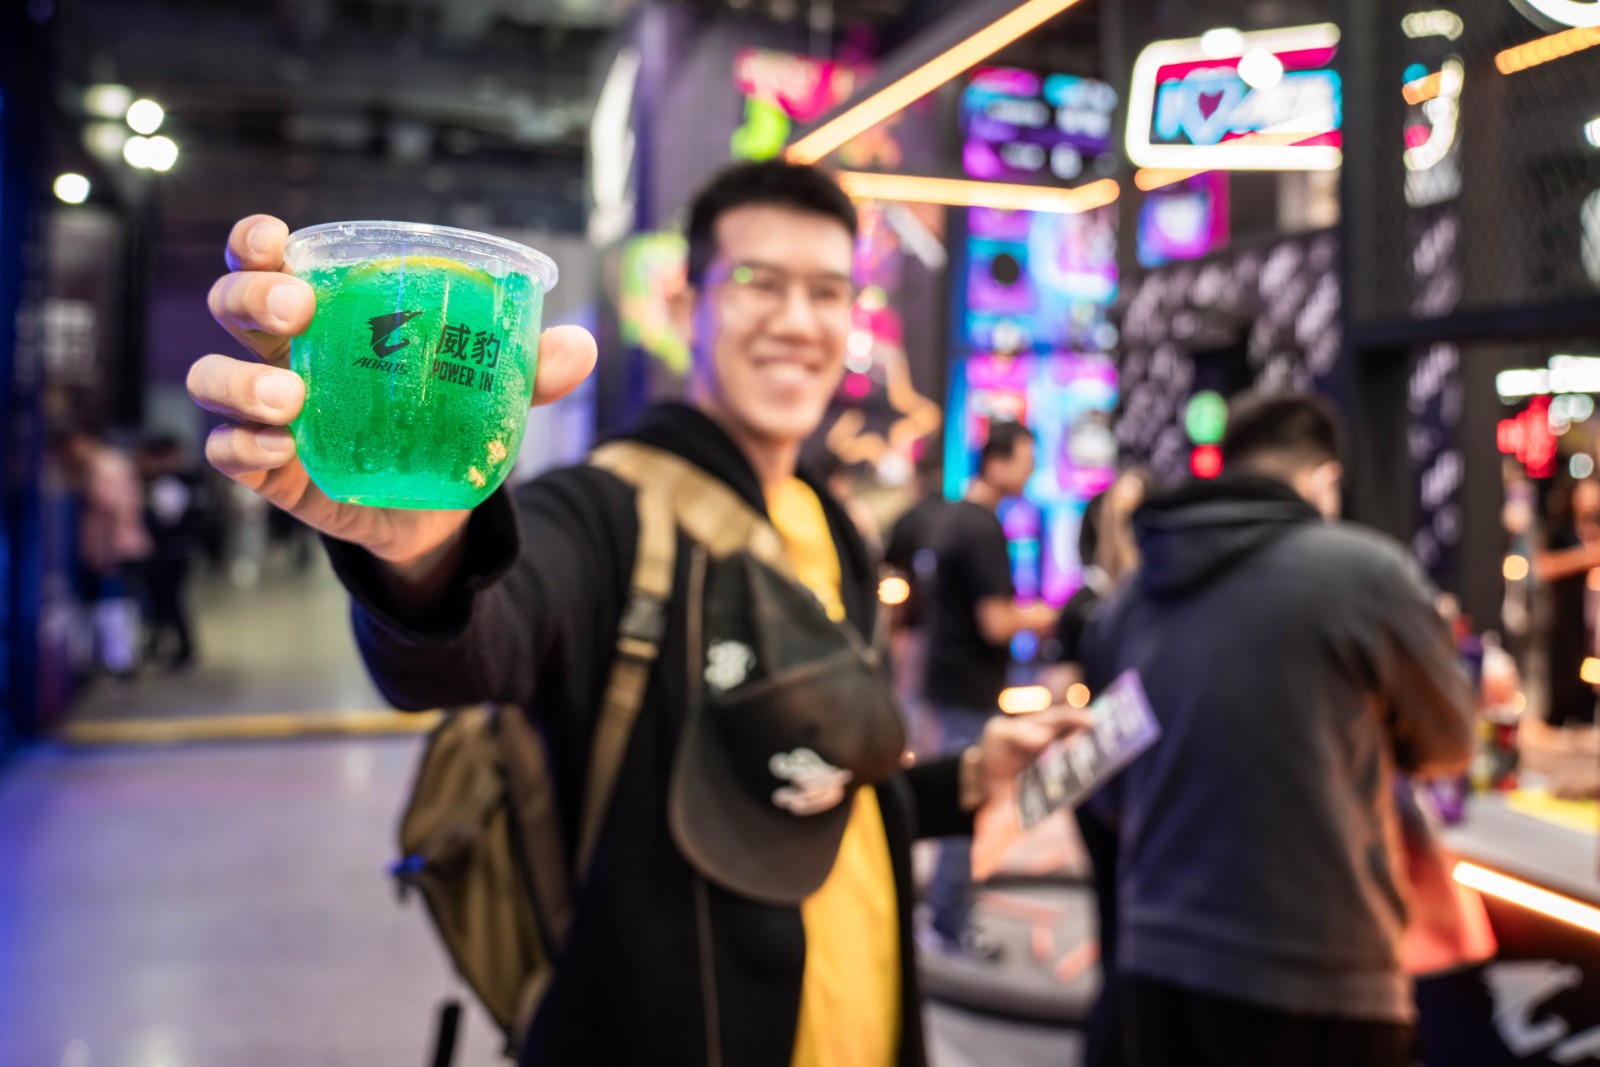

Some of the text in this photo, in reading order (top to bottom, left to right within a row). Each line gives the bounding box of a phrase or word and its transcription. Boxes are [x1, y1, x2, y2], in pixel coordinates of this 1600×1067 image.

[435, 323, 501, 369] 威豹
[352, 357, 411, 375] AORUS
[431, 359, 495, 393] POWER IN
